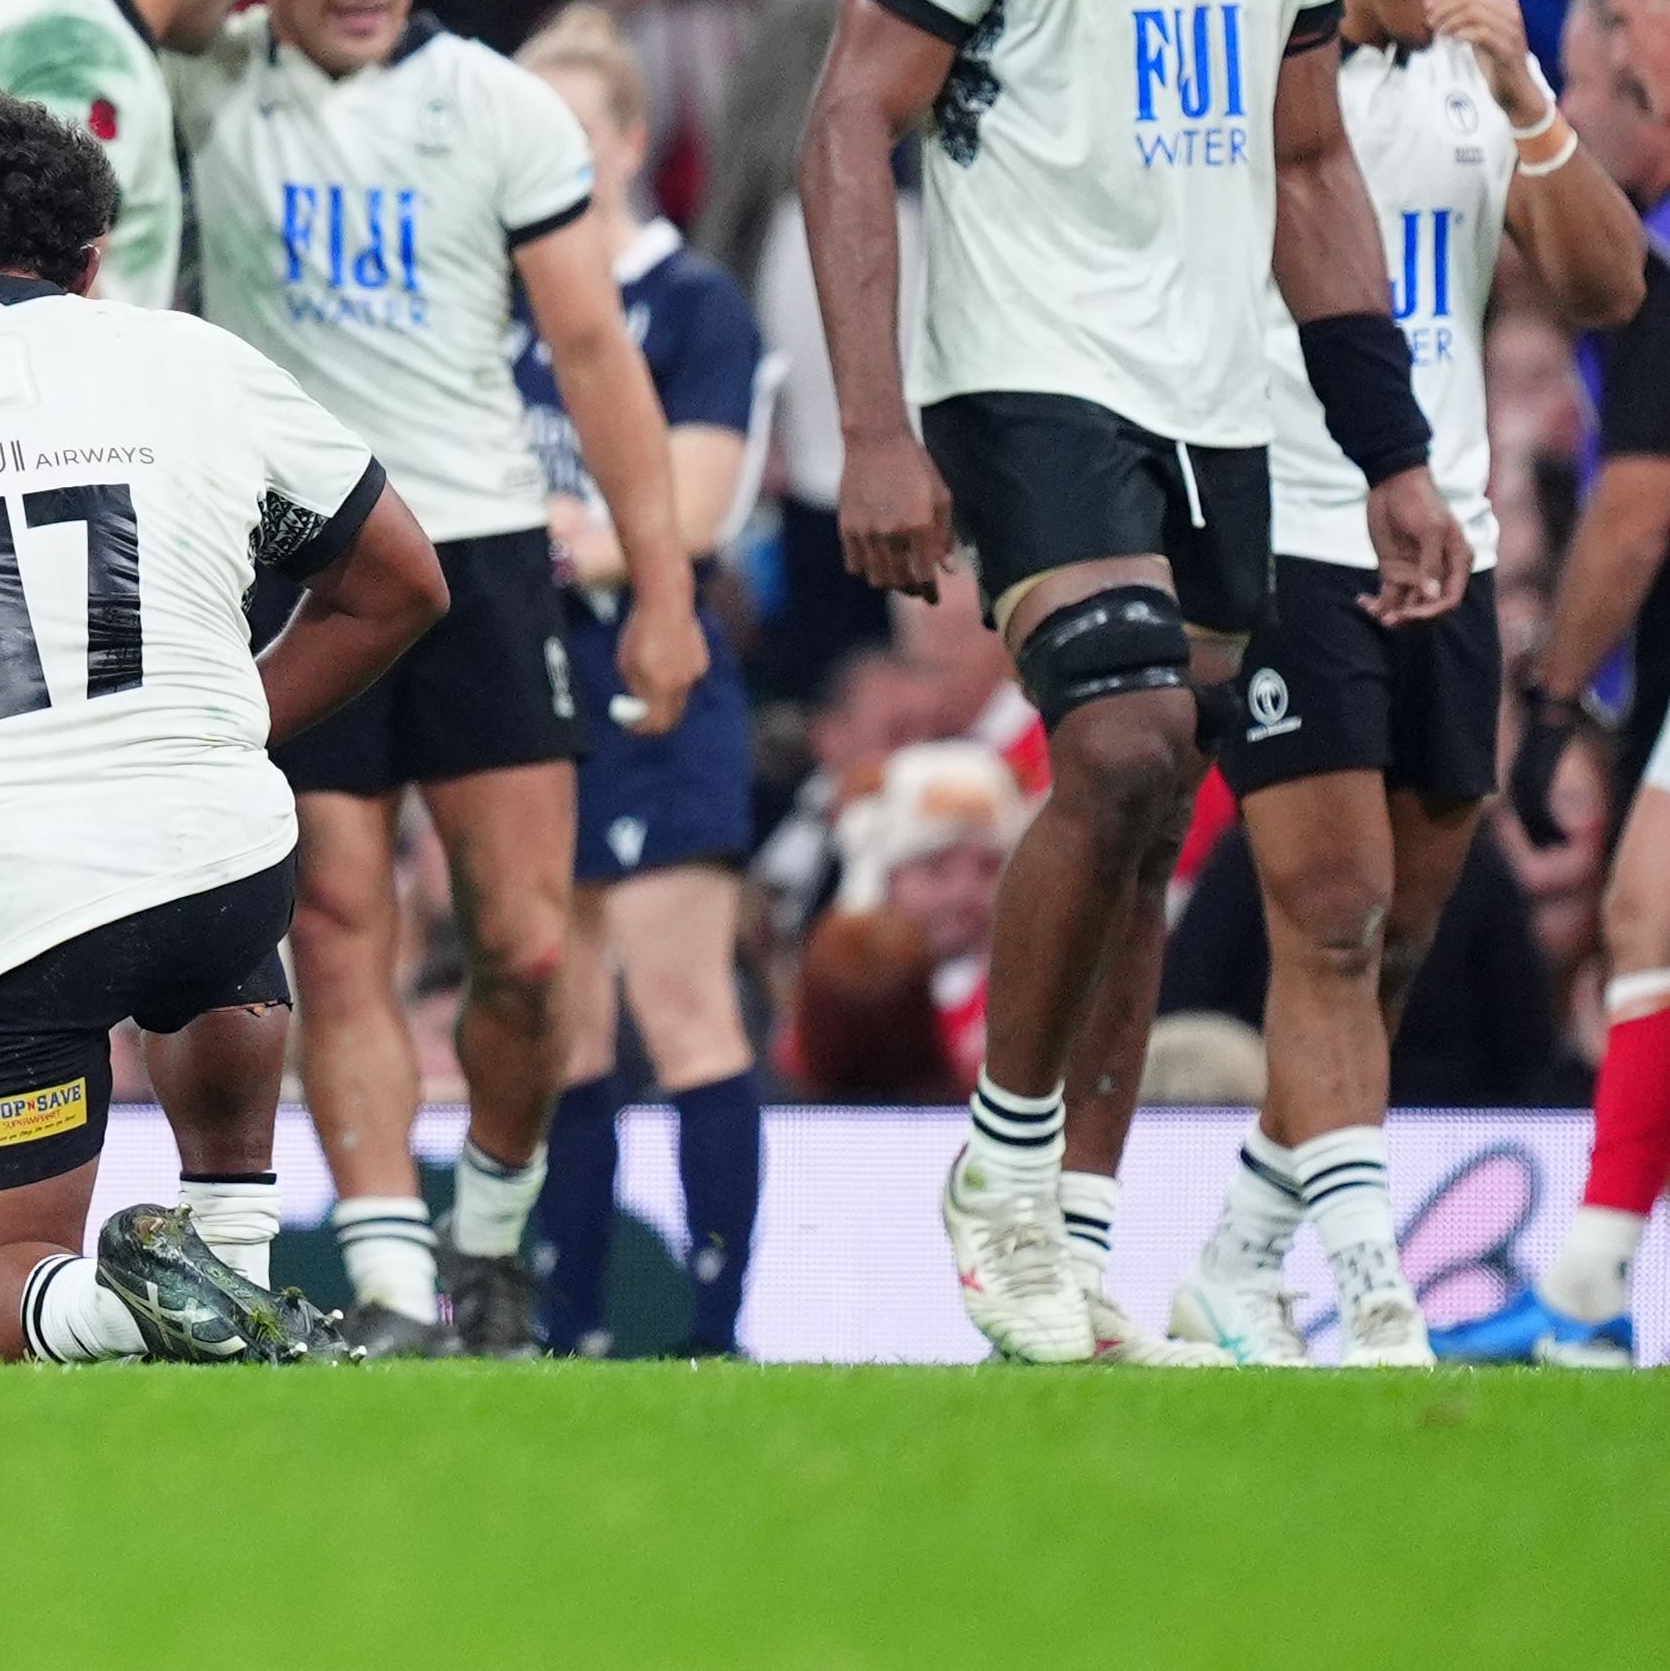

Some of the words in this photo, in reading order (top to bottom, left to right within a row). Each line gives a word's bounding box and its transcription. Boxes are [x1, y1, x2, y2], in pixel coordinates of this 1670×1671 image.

[1135, 129, 1249, 168] WTER
[282, 184, 417, 290] FIJI
[1391, 208, 1452, 320] JI
[36, 447, 155, 469] AIRWAYS
[37, 1084, 82, 1112] SAVE
